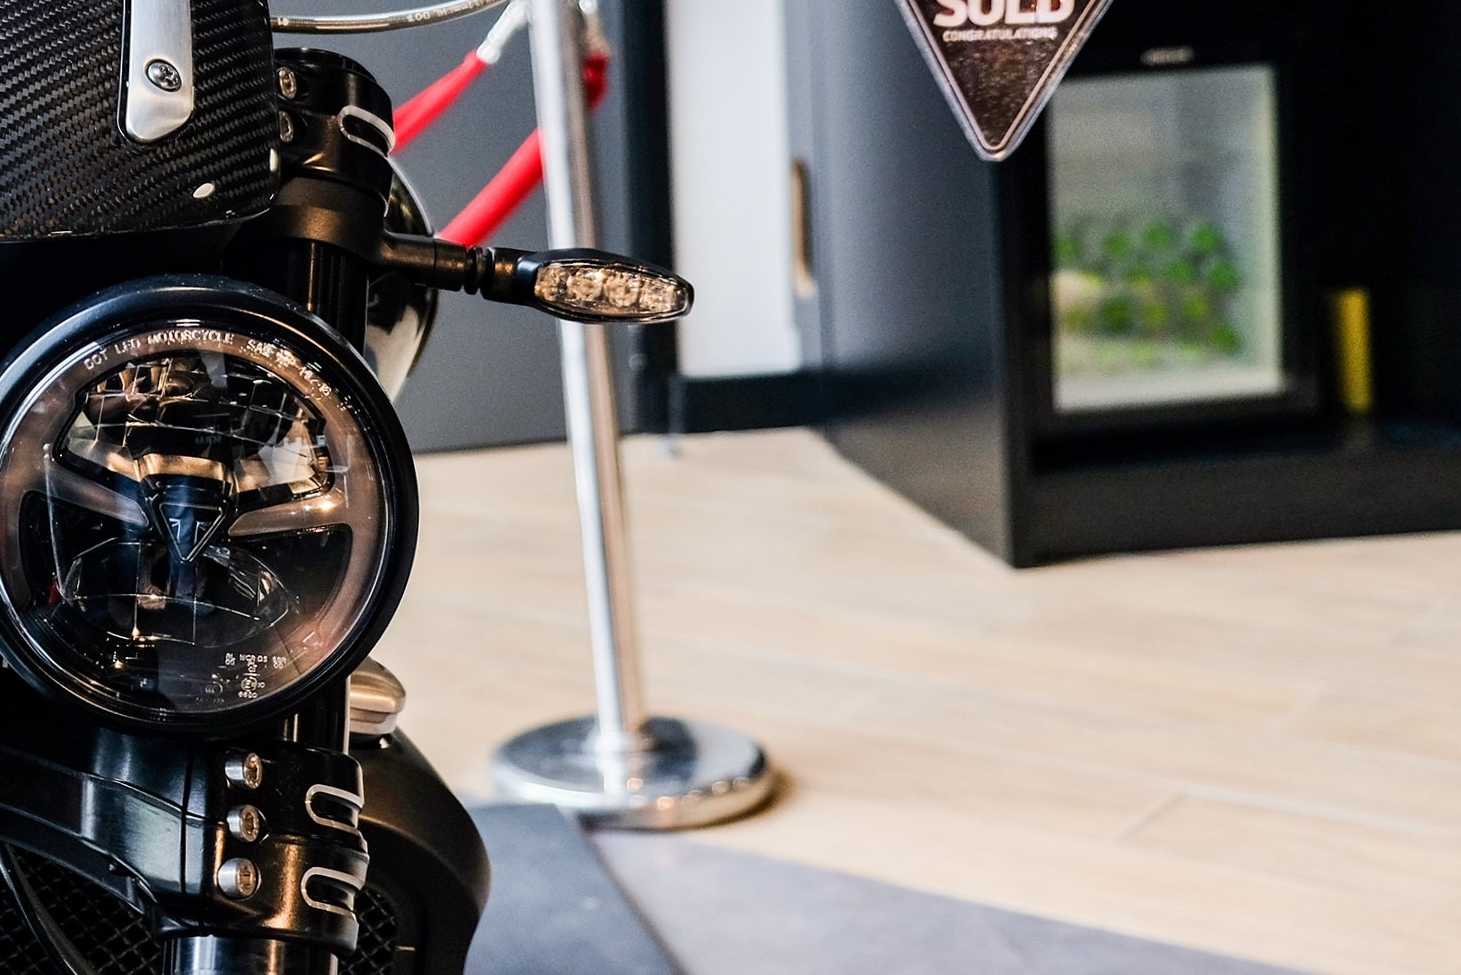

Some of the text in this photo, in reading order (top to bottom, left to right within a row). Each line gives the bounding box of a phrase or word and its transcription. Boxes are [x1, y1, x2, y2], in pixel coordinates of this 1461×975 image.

[406, 11, 431, 23] DOT
[942, 27, 1058, 42] CONGRATULATIONS
[83, 349, 108, 370] DOT
[147, 329, 235, 345] MOTORCYCLE
